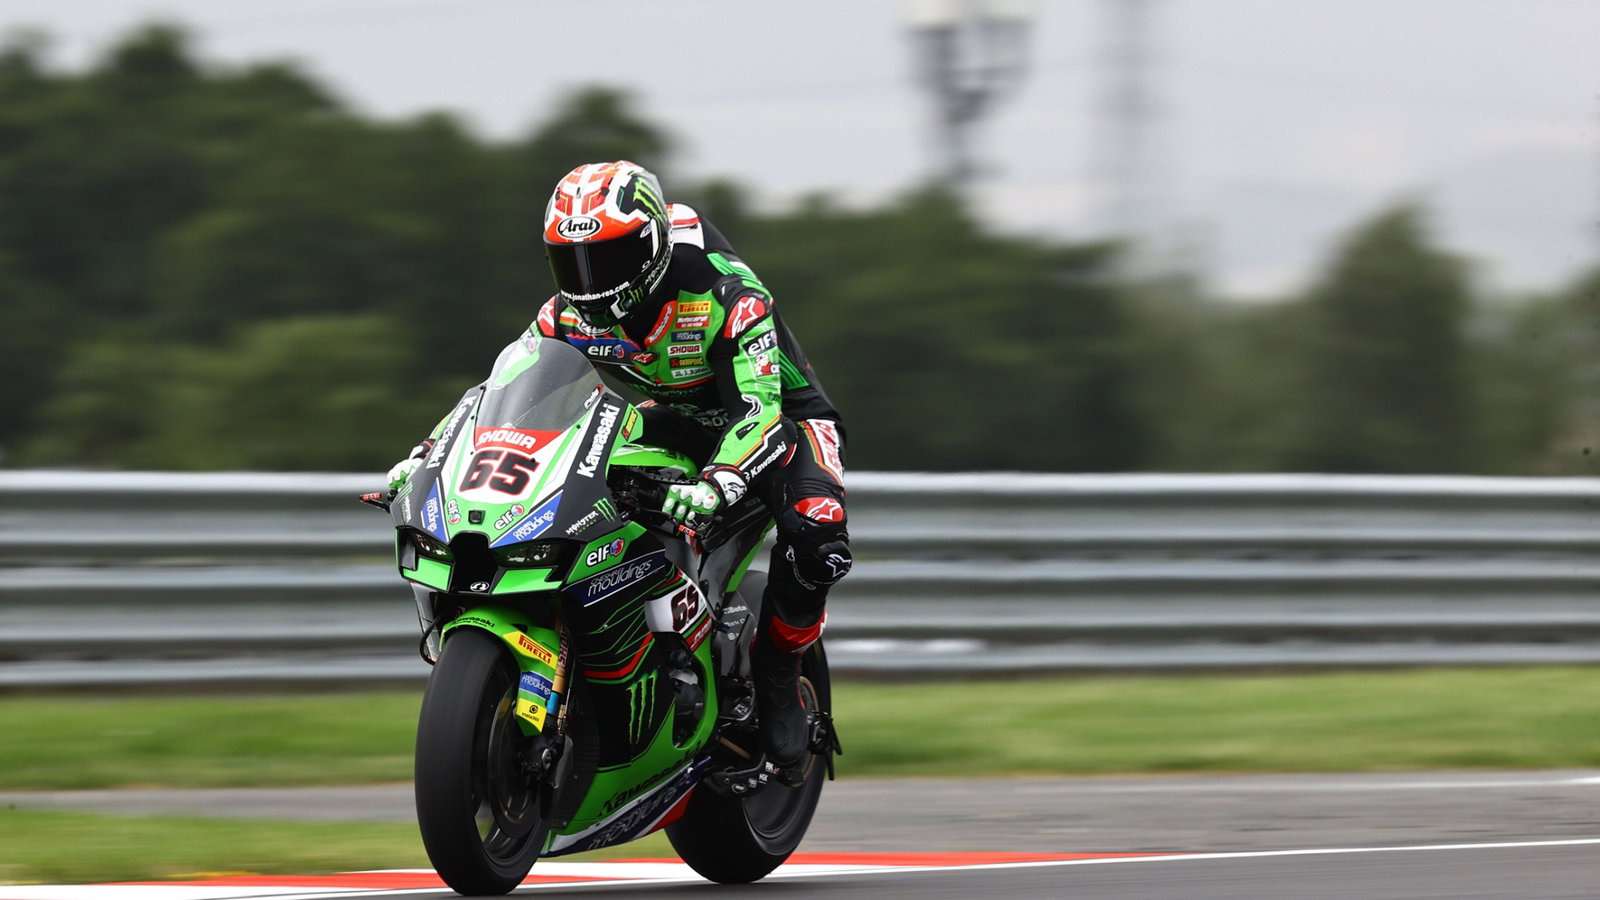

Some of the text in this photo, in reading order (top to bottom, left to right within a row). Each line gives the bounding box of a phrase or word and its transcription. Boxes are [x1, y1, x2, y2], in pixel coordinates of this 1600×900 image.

[561, 218, 594, 233] Arai
[560, 281, 630, 301] www.jonathan-rea.com
[680, 303, 709, 312] PIRELLI
[588, 345, 612, 356] elf
[670, 345, 700, 354] SHOWA
[748, 333, 771, 355] elf
[426, 396, 477, 469] Kawasaki
[476, 430, 536, 449] SHOWA
[577, 403, 620, 478] Kawasaki
[750, 441, 787, 478] Kawasaki
[459, 449, 541, 496] 65
[448, 499, 459, 515] elf
[494, 511, 513, 530] elf
[515, 510, 555, 541] mouldings
[565, 510, 599, 535] MONSTER
[586, 544, 610, 566] elf
[588, 559, 652, 597] mouldings
[519, 634, 552, 664] PIRELLI
